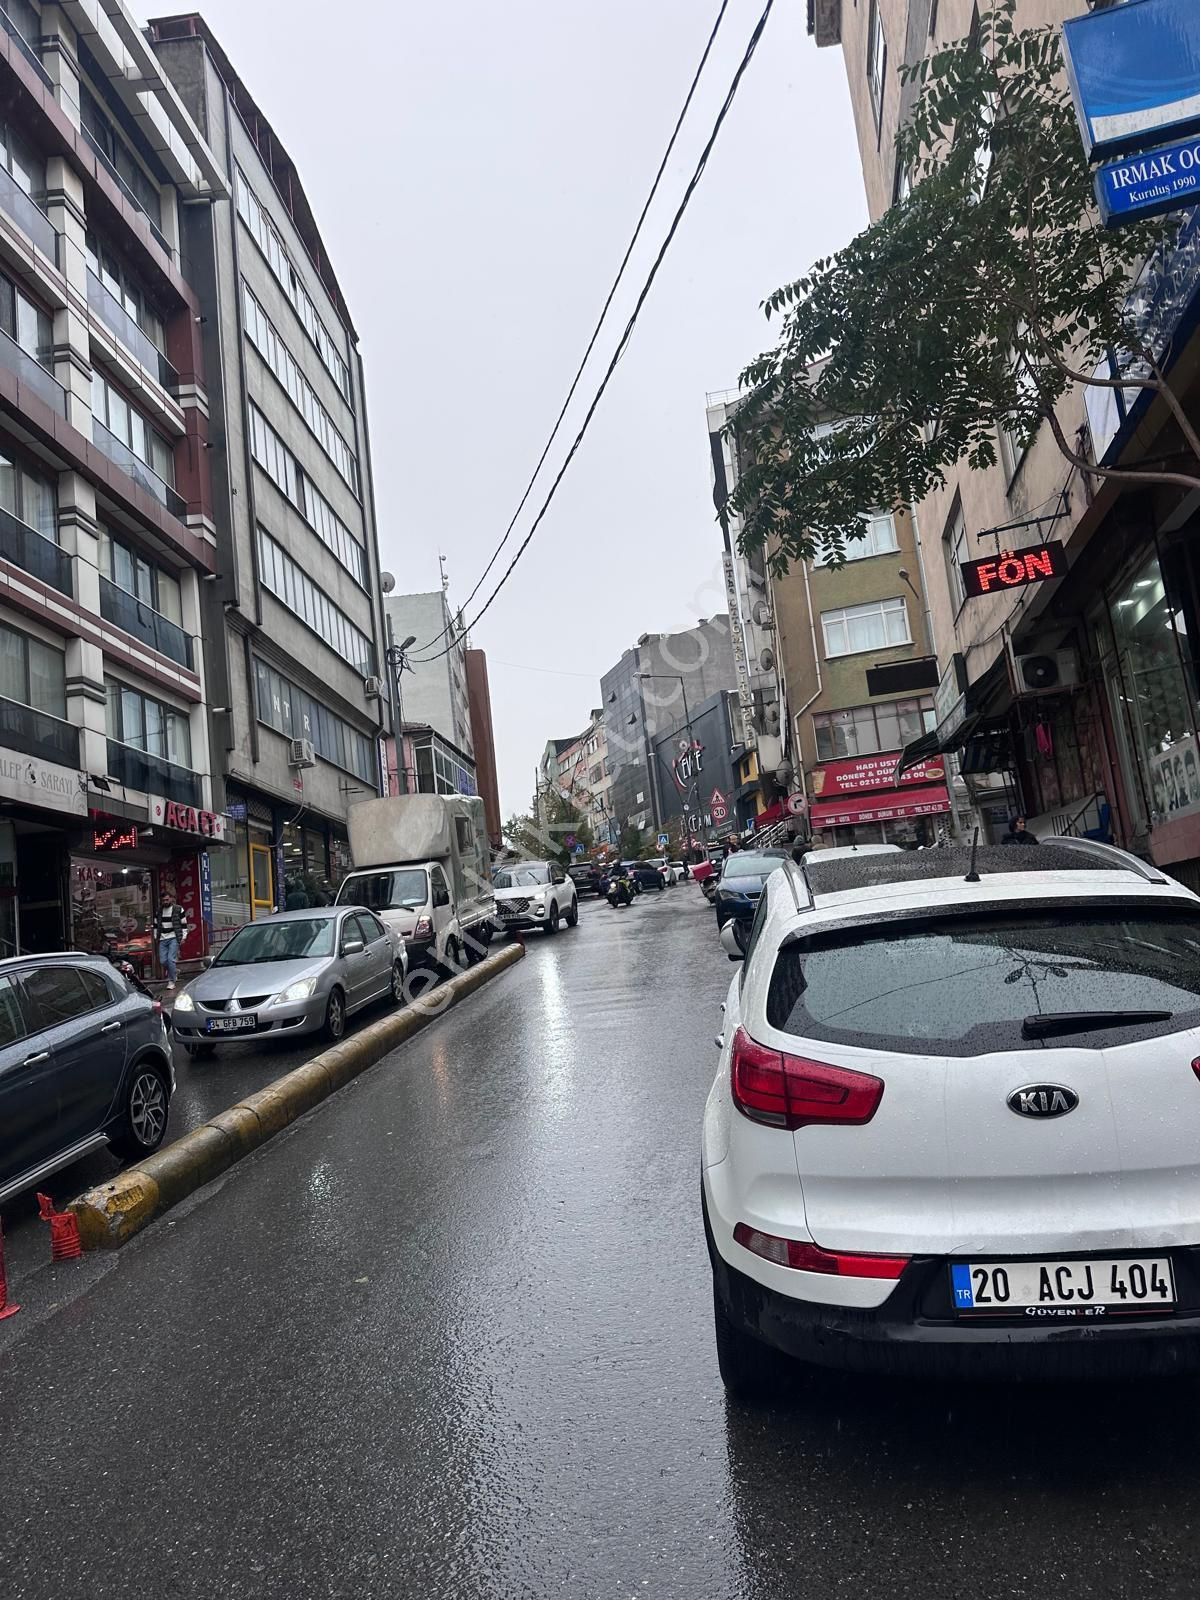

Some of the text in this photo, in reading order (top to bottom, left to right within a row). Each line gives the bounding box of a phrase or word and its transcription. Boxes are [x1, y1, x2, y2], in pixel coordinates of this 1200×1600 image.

[1110, 153, 1176, 190] IRMAK
[1129, 175, 1196, 203] Kuruluş 1990
[976, 550, 1053, 591] FÖN
[40, 771, 73, 795] SARAYI
[836, 772, 866, 782] DÖNER
[859, 778, 880, 786] 0212
[199, 810, 216, 835] ET
[714, 808, 725, 817] 30
[210, 1015, 254, 1029] 34 GFB 759
[1019, 1090, 1069, 1112] KIA
[956, 1289, 971, 1300] TR
[972, 1263, 1169, 1304] 20 ACJ 404
